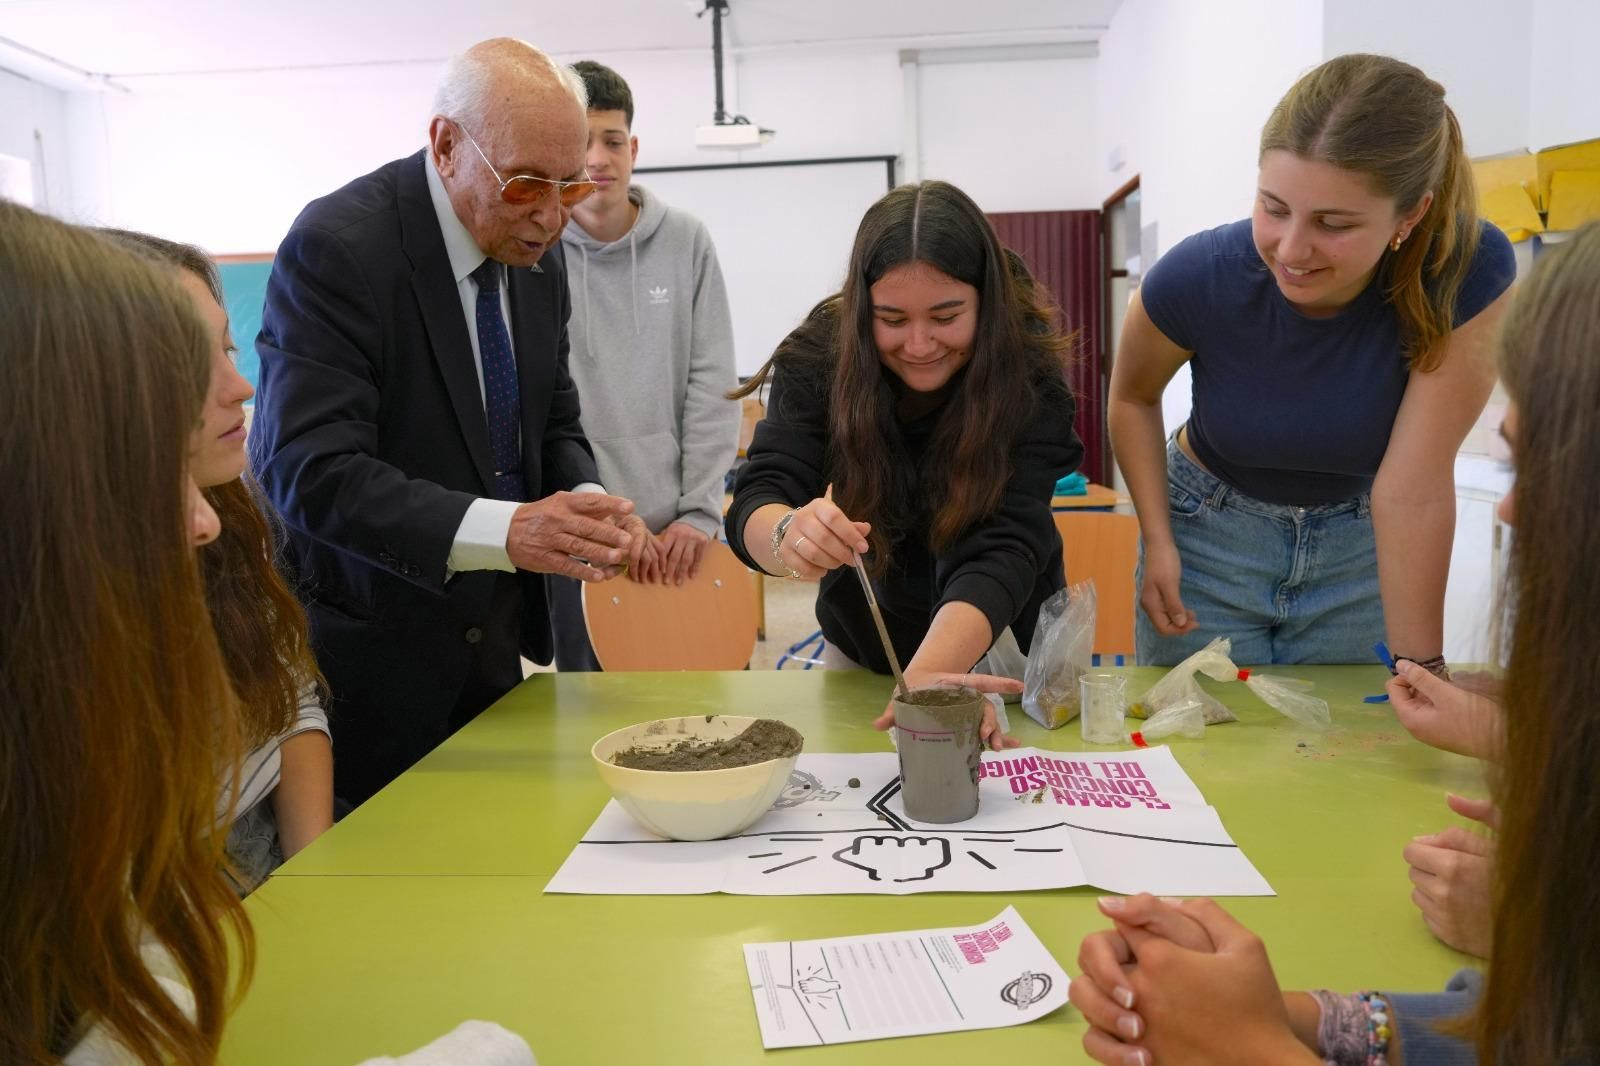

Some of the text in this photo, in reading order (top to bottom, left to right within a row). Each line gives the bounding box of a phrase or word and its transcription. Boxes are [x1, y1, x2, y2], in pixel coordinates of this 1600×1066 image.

[977, 755, 1146, 783] DEL HORMIGÓ
[1010, 771, 1158, 797] CONCURSO
[1051, 787, 1171, 810] EL GRAN
